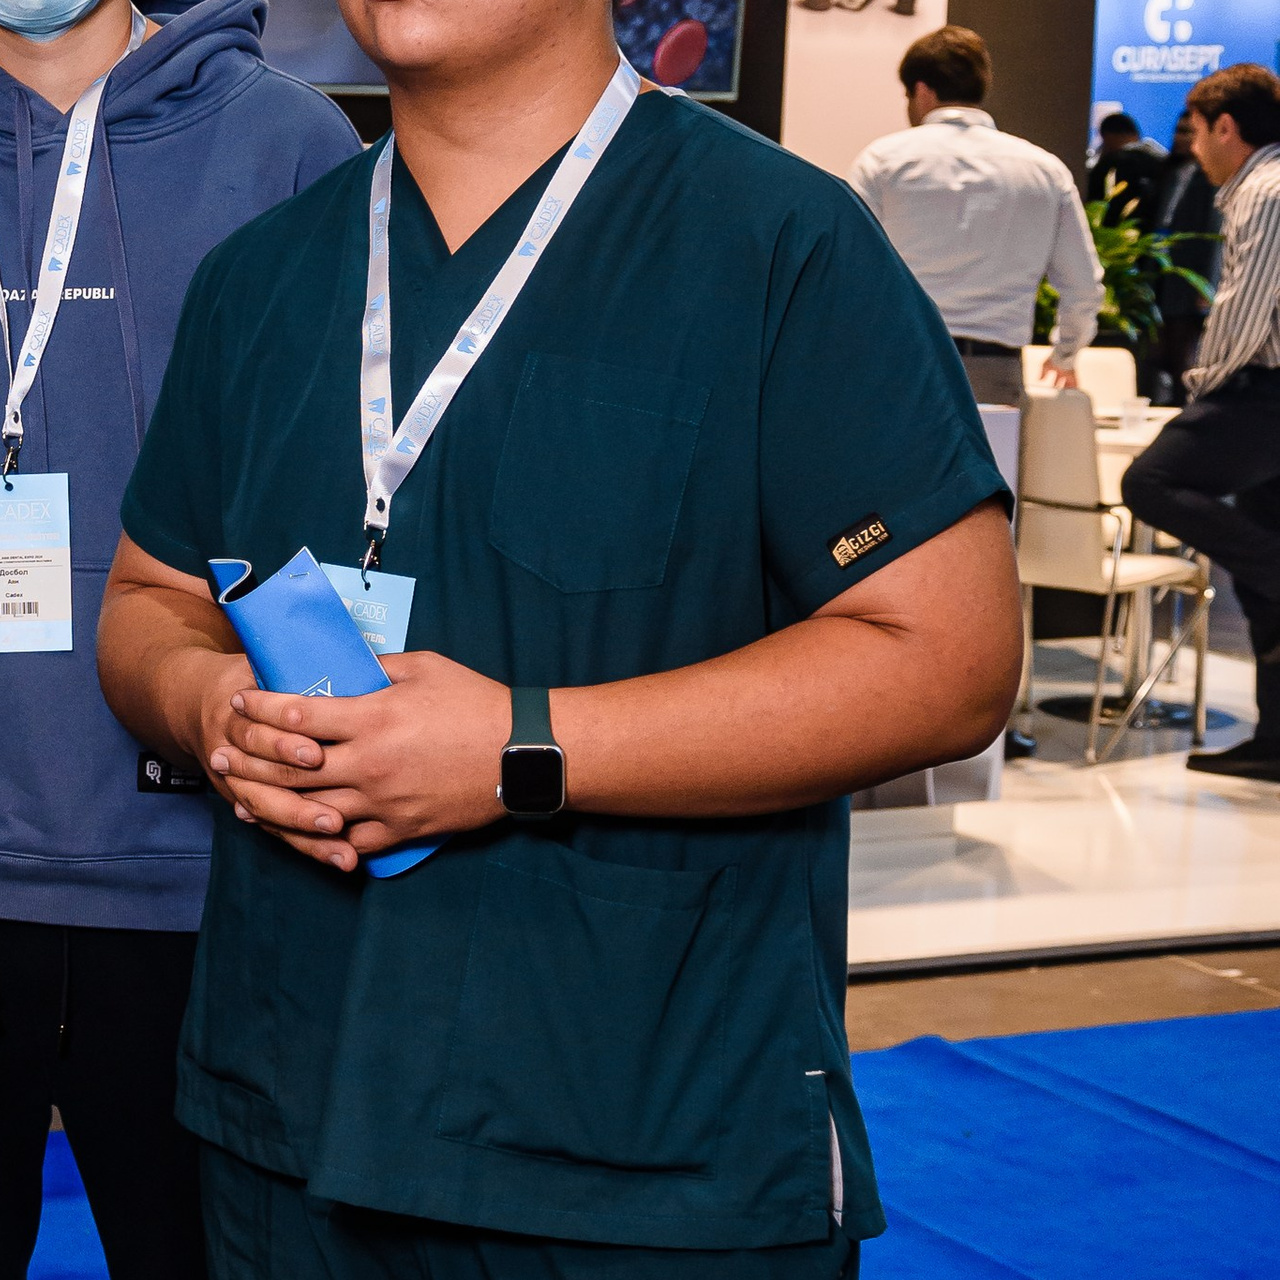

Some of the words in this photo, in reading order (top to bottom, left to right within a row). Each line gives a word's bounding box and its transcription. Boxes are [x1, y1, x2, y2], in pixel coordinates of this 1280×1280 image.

[70, 117, 88, 160] CADEX
[52, 214, 73, 256] CADEX
[530, 195, 560, 240] CADEX
[2, 289, 39, 302] QAZA
[61, 287, 115, 300] EPUBLI
[30, 310, 51, 352] CADEX
[469, 294, 503, 338] CADEX
[0, 568, 28, 577] Досбол
[354, 603, 387, 621] CADEX
